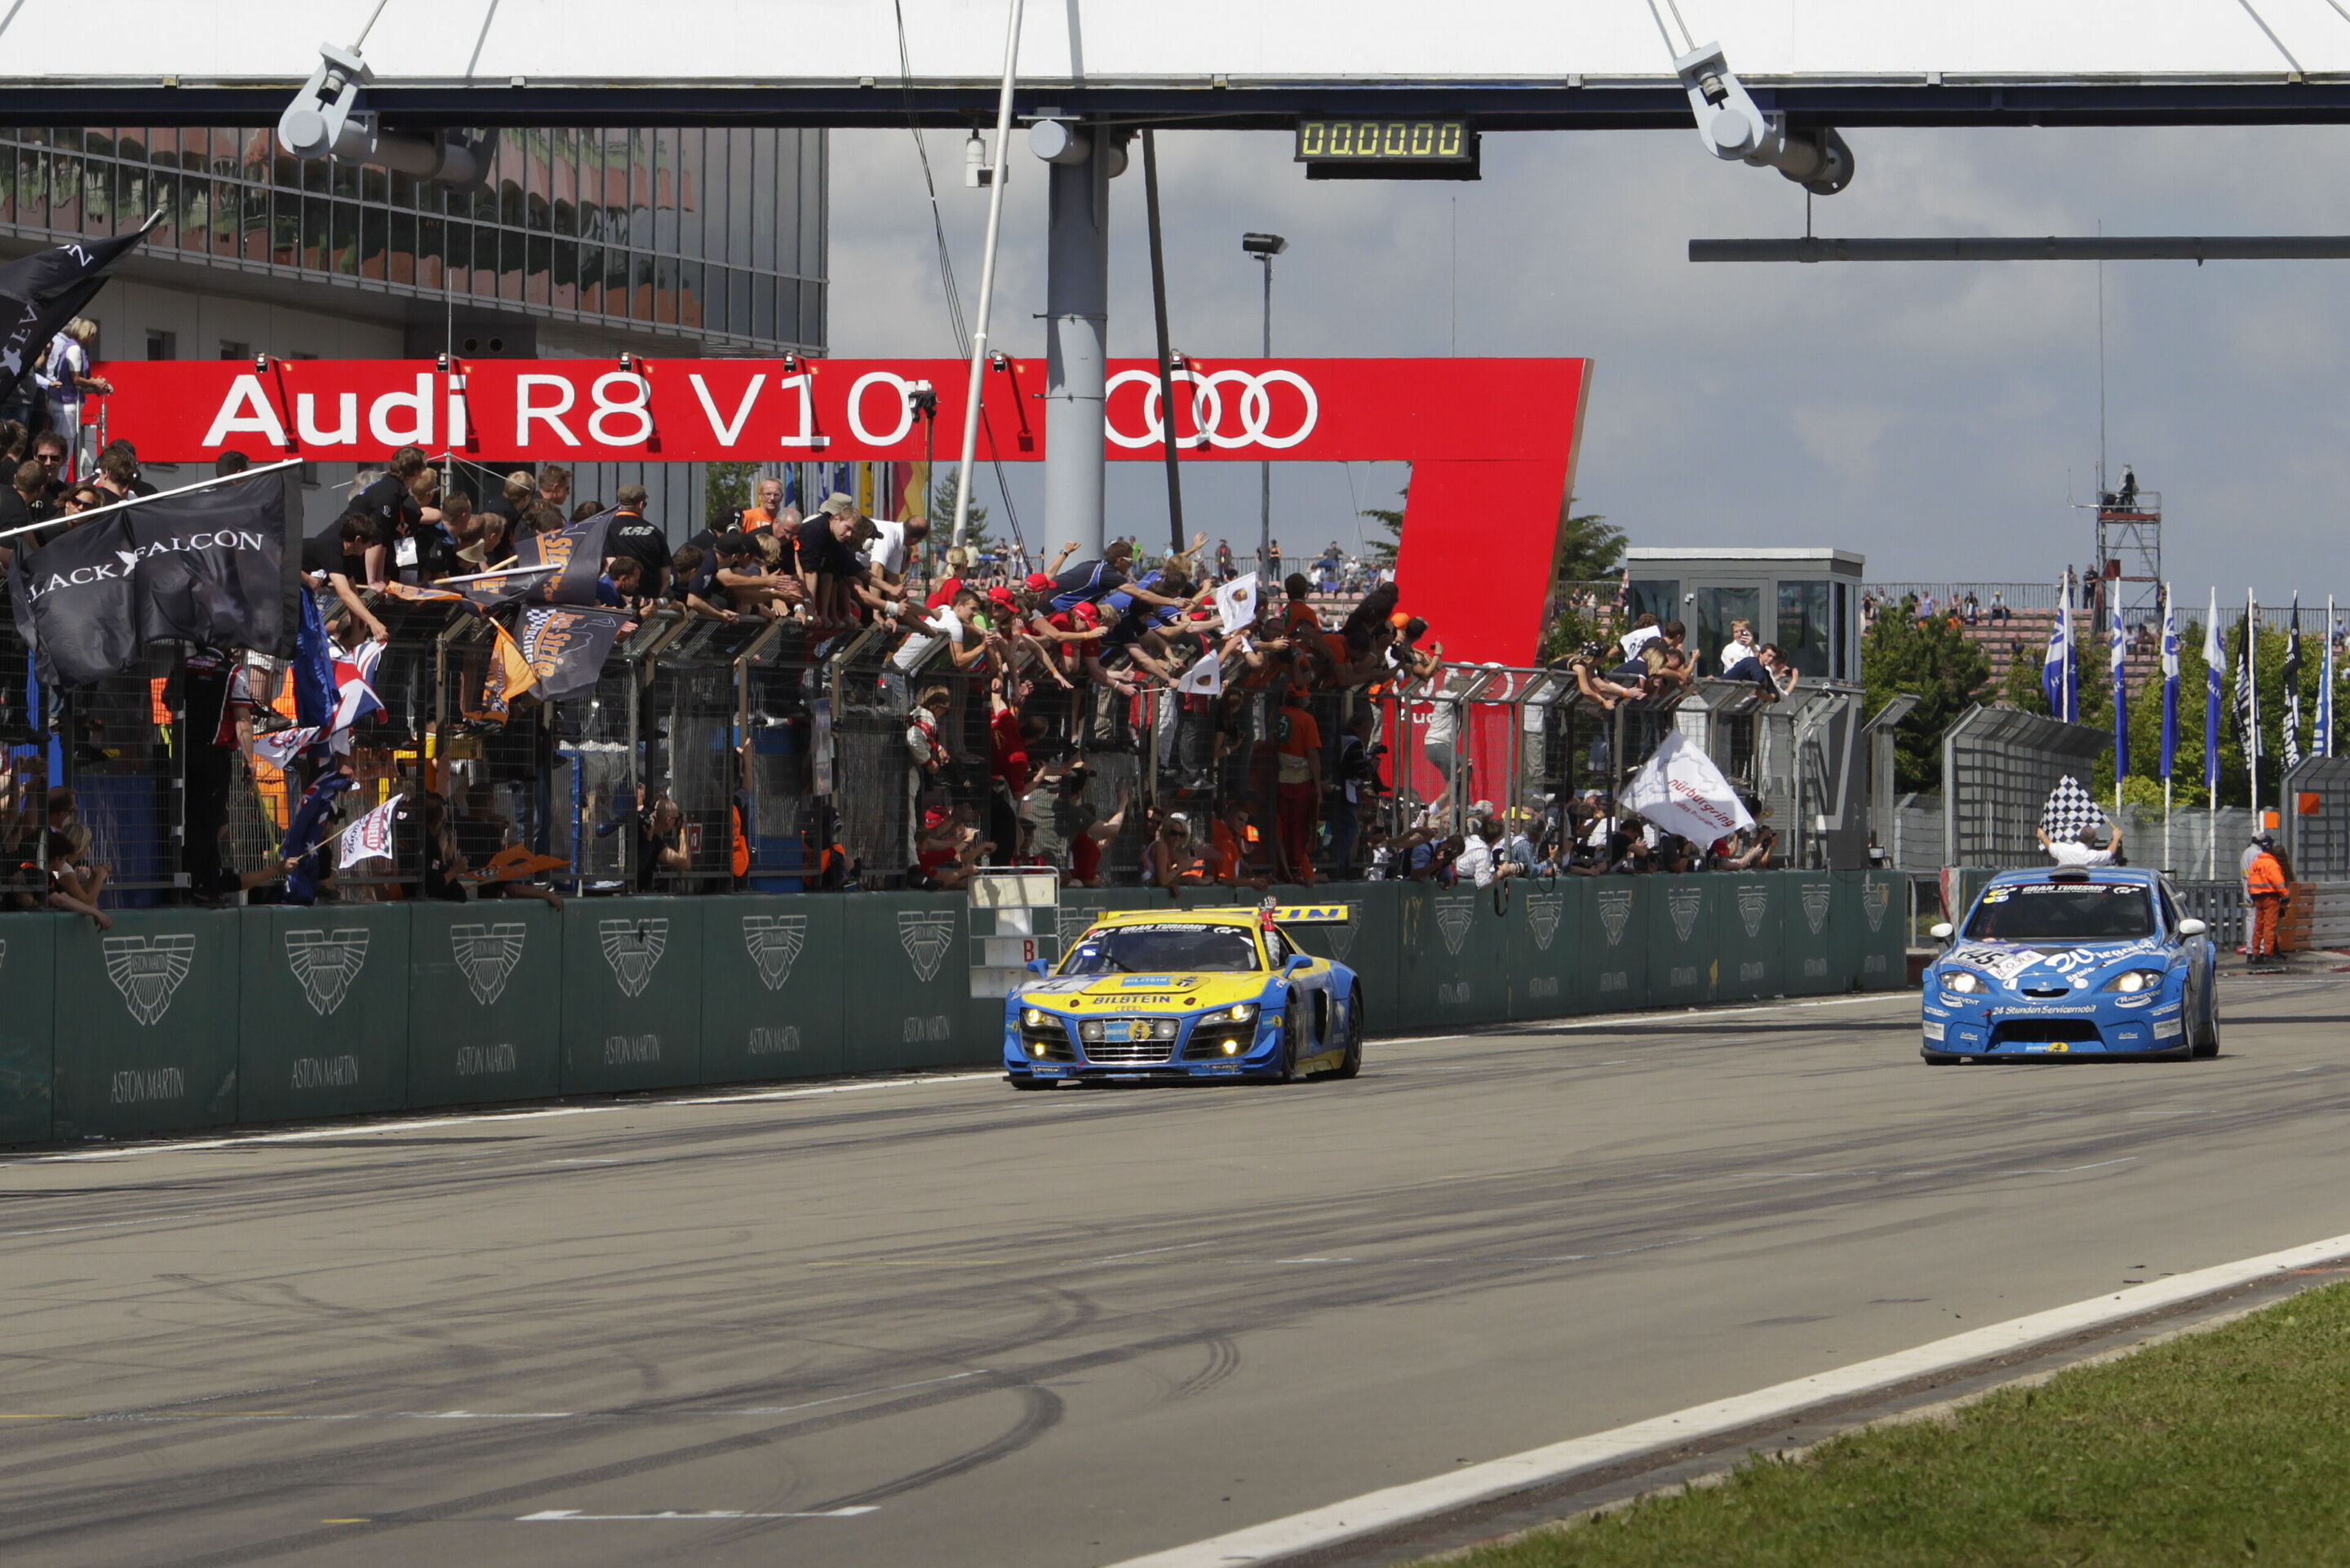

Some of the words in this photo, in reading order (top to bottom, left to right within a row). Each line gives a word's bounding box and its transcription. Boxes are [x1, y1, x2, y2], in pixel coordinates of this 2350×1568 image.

[202, 373, 466, 446] Audi
[517, 373, 652, 447] R8
[689, 373, 916, 447] V10
[133, 529, 264, 563] FALCON
[1023, 940, 1035, 962] B
[1093, 995, 1171, 1004] BILSTEIN
[1993, 1007, 2004, 1016] 24
[2005, 1006, 2041, 1014] Stunden
[2041, 1004, 2097, 1014] Servicemobil
[292, 1057, 322, 1090] ASTON
[325, 1055, 358, 1087] MARTIN
[456, 1046, 484, 1075] ASTON
[486, 1043, 517, 1073] MARTIN
[111, 1070, 144, 1103] ASTON
[147, 1067, 184, 1099] MARTIN
